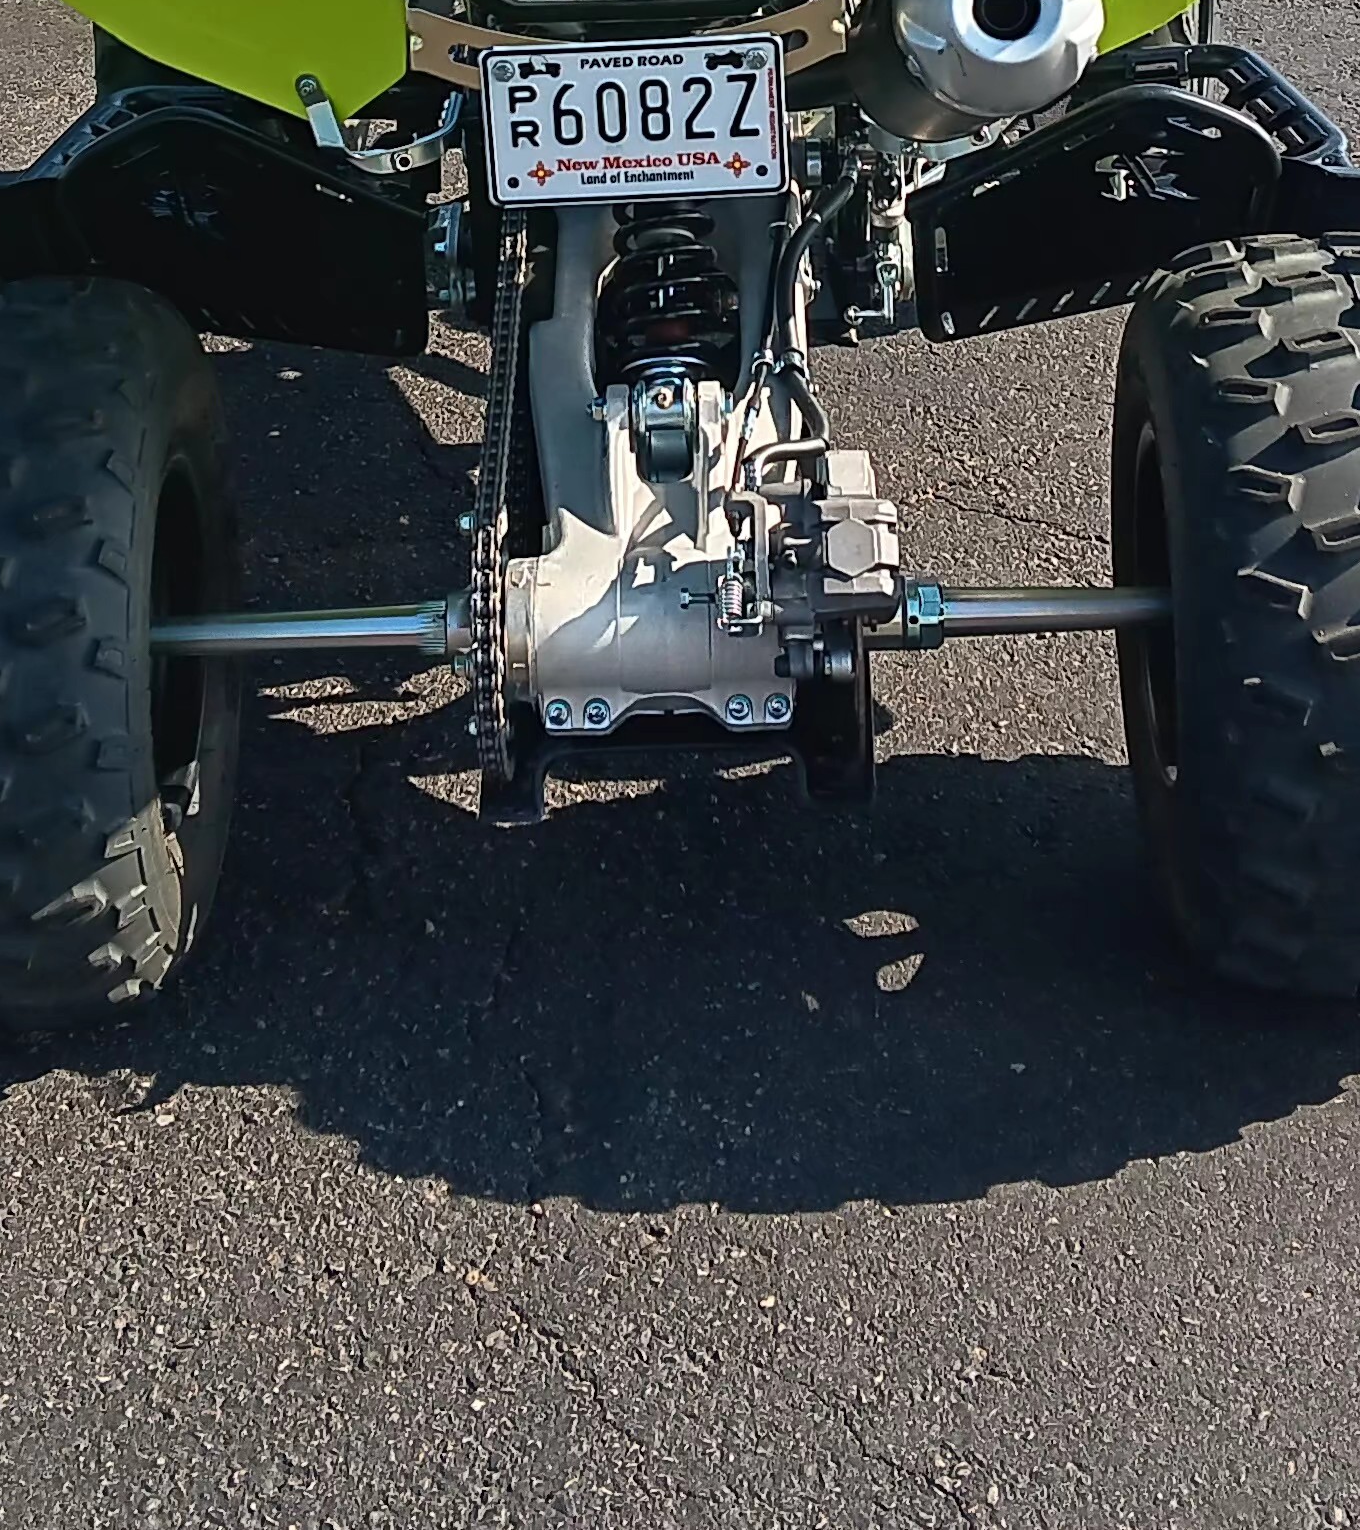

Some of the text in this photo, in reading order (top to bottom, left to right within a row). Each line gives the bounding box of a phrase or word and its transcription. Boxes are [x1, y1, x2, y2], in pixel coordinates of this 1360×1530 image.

[580, 53, 684, 70] PAVED ROAD
[552, 72, 760, 147] 6082Z
[556, 152, 721, 172] New Mexico USA
[580, 169, 695, 185] Land of Enchantment
